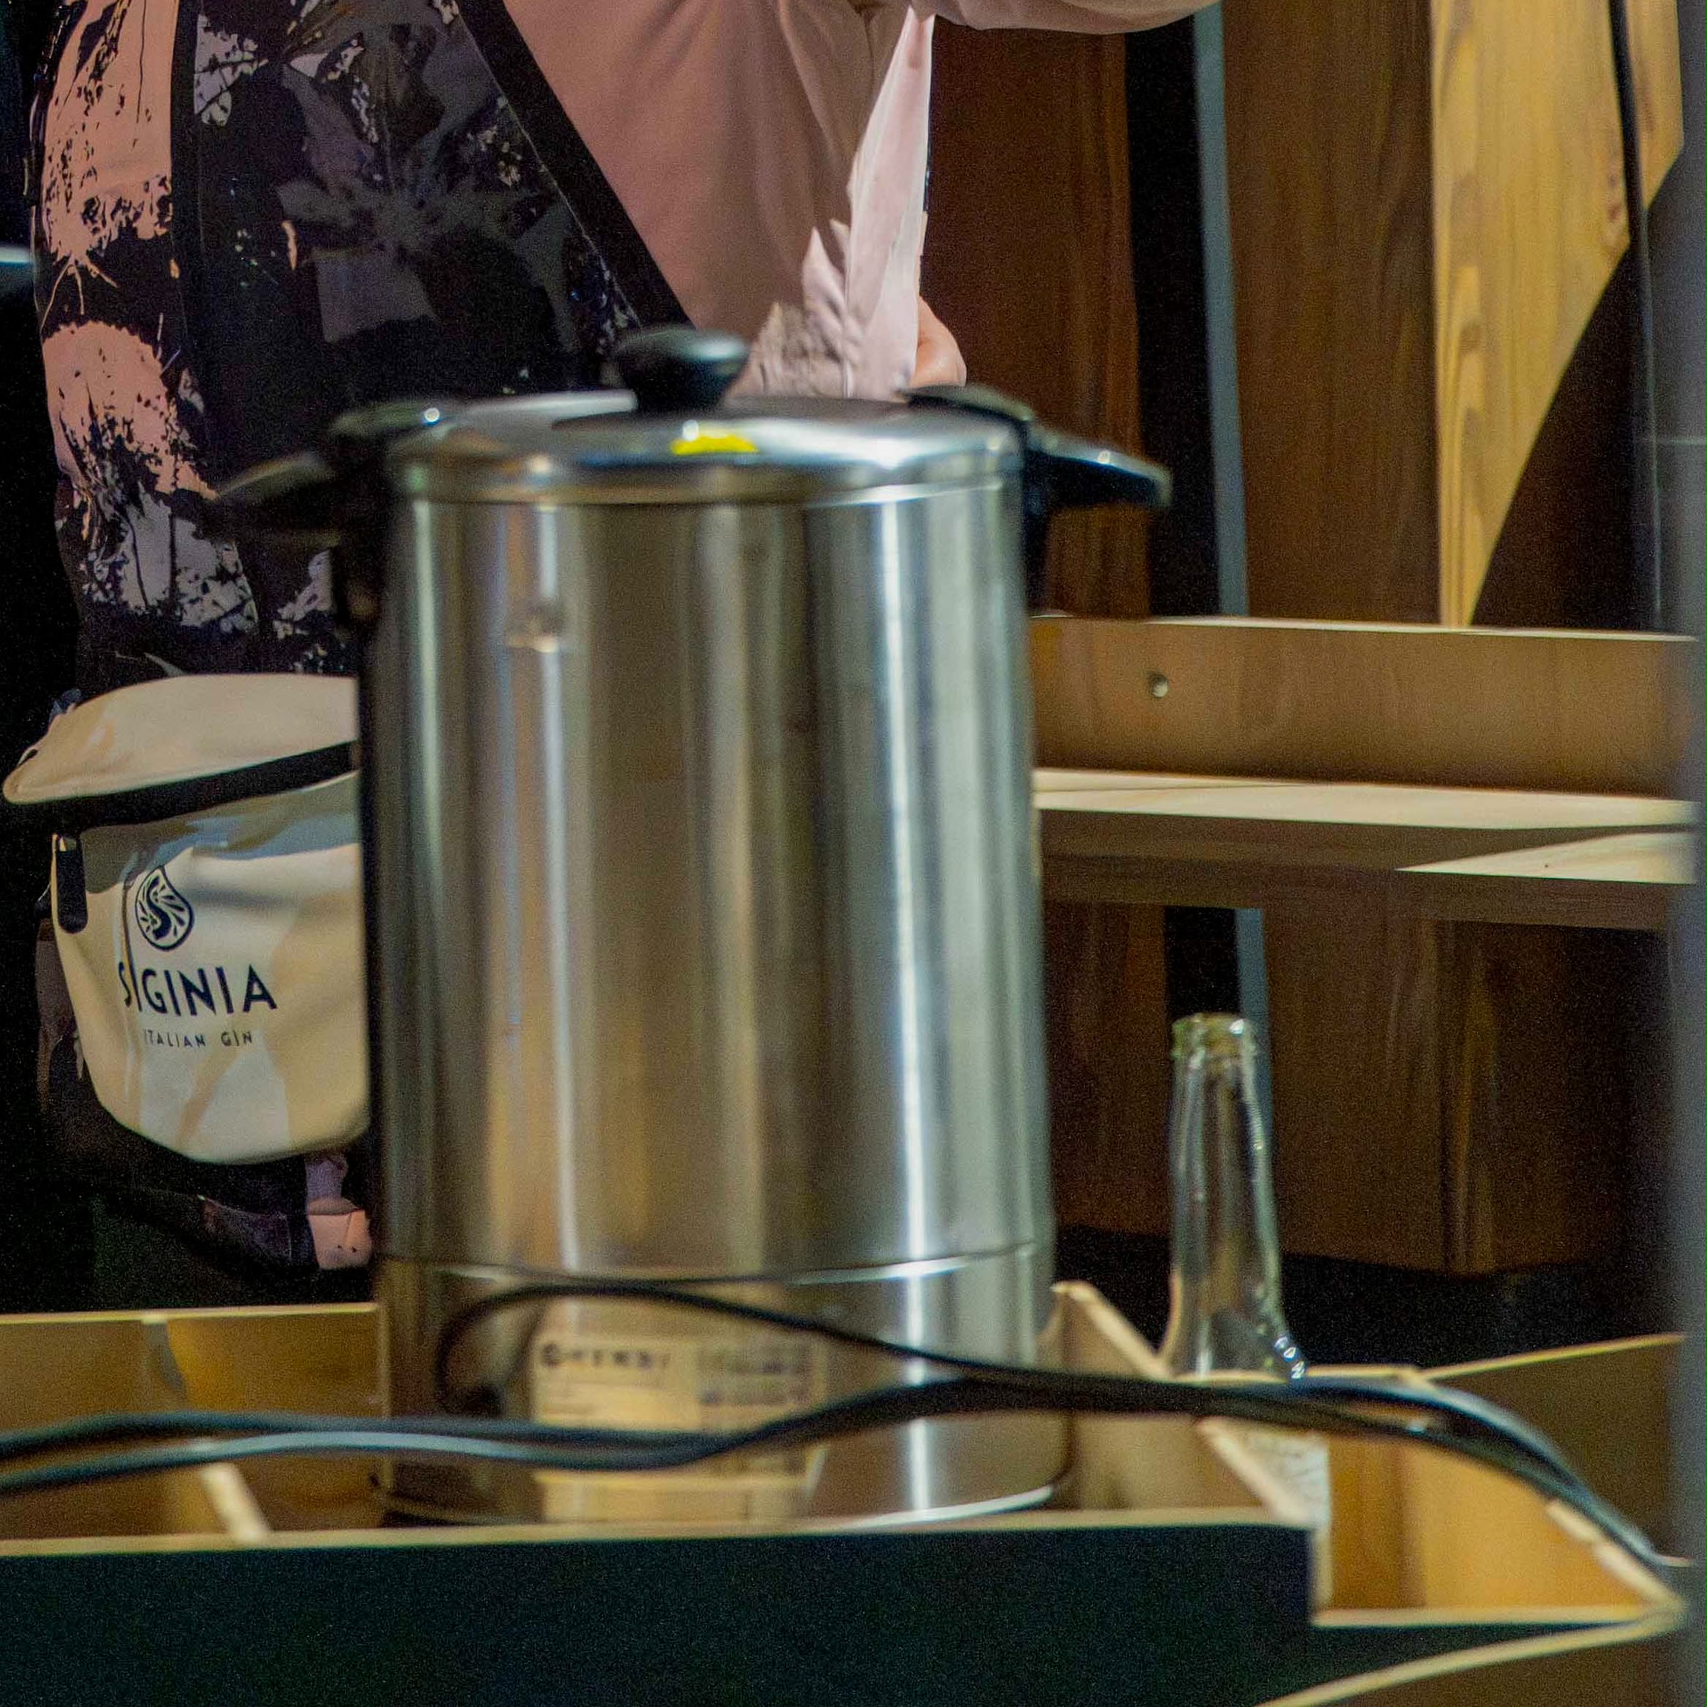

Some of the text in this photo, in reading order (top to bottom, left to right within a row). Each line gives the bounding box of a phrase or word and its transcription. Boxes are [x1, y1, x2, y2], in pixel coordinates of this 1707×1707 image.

[118, 960, 278, 1017] SIGINIA
[144, 1029, 253, 1048] ITALIAN GIN
